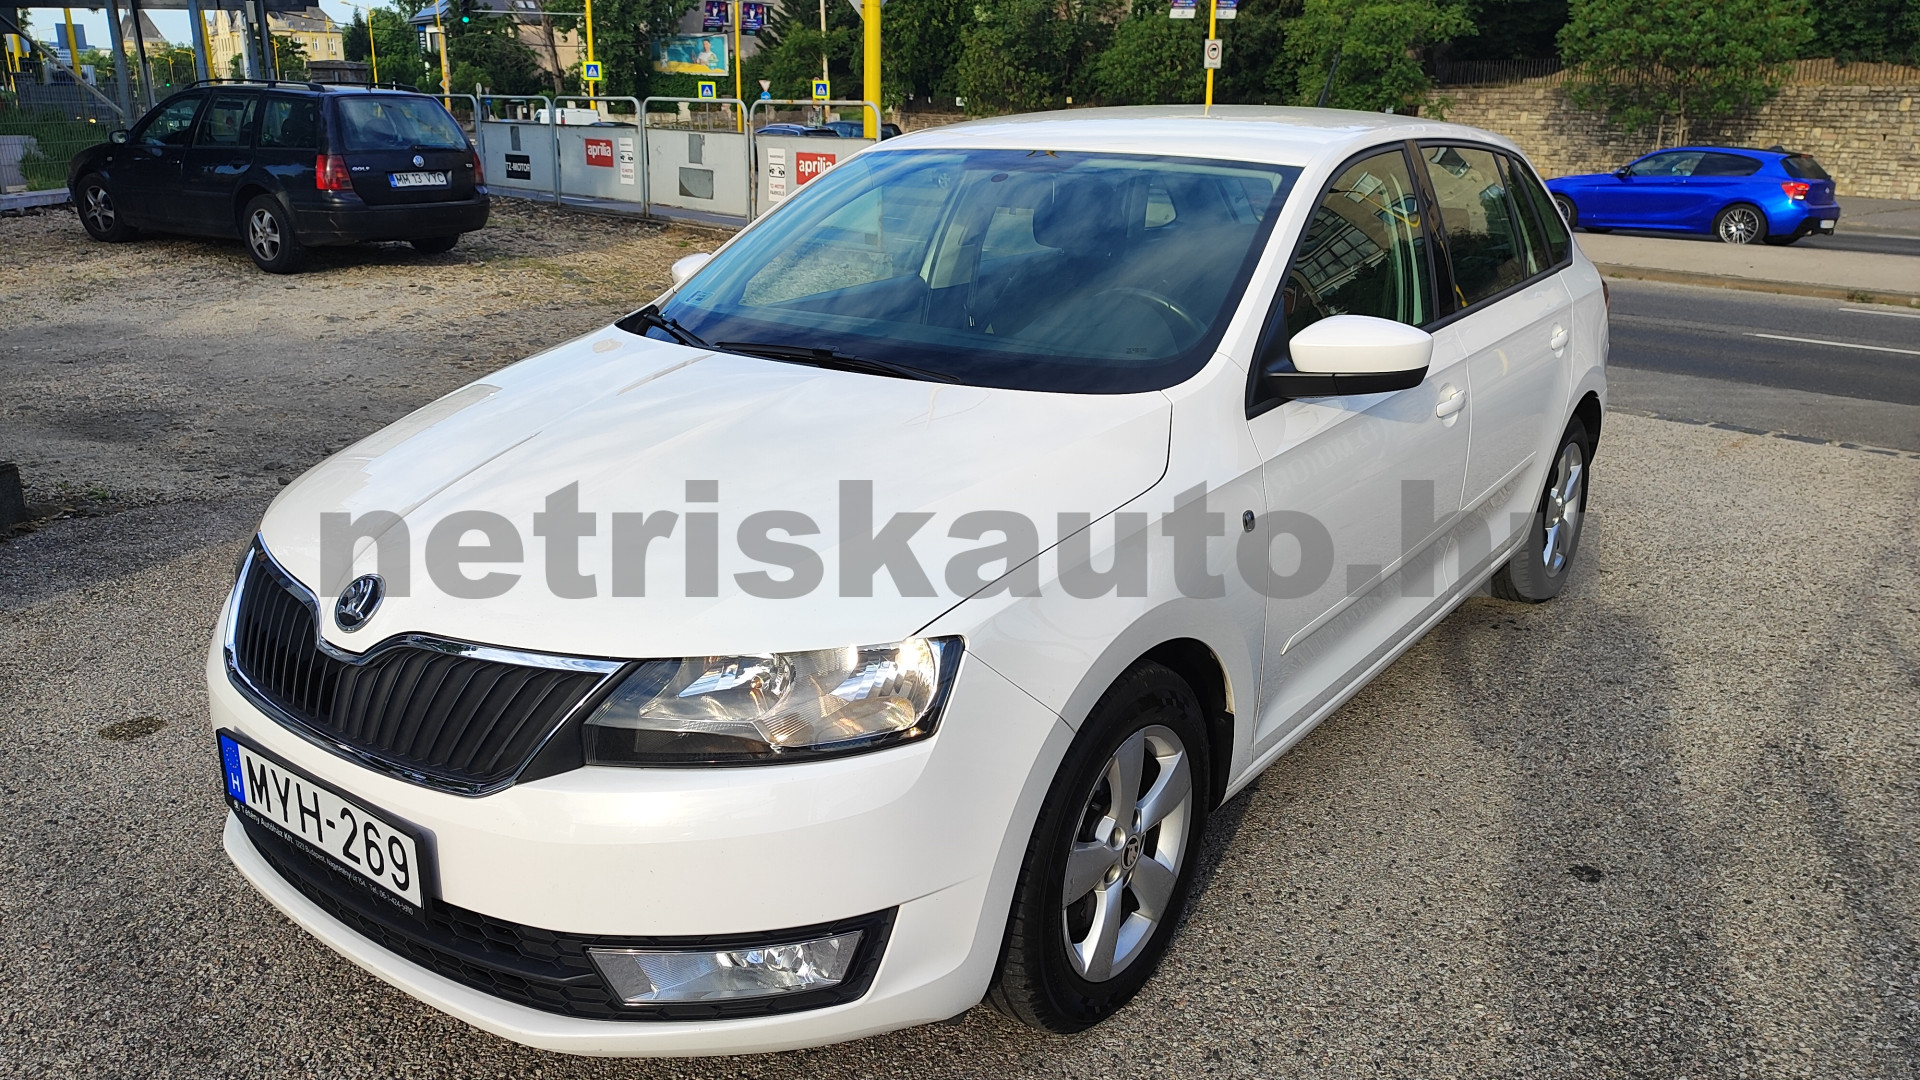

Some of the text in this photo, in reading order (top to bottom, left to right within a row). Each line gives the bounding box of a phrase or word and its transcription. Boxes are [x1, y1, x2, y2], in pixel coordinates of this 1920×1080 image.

[587, 142, 612, 159] aprilia
[799, 156, 833, 177] aprilia
[395, 171, 446, 185] MM 13 VYC
[231, 771, 241, 793] H
[246, 754, 410, 892] MYH-269
